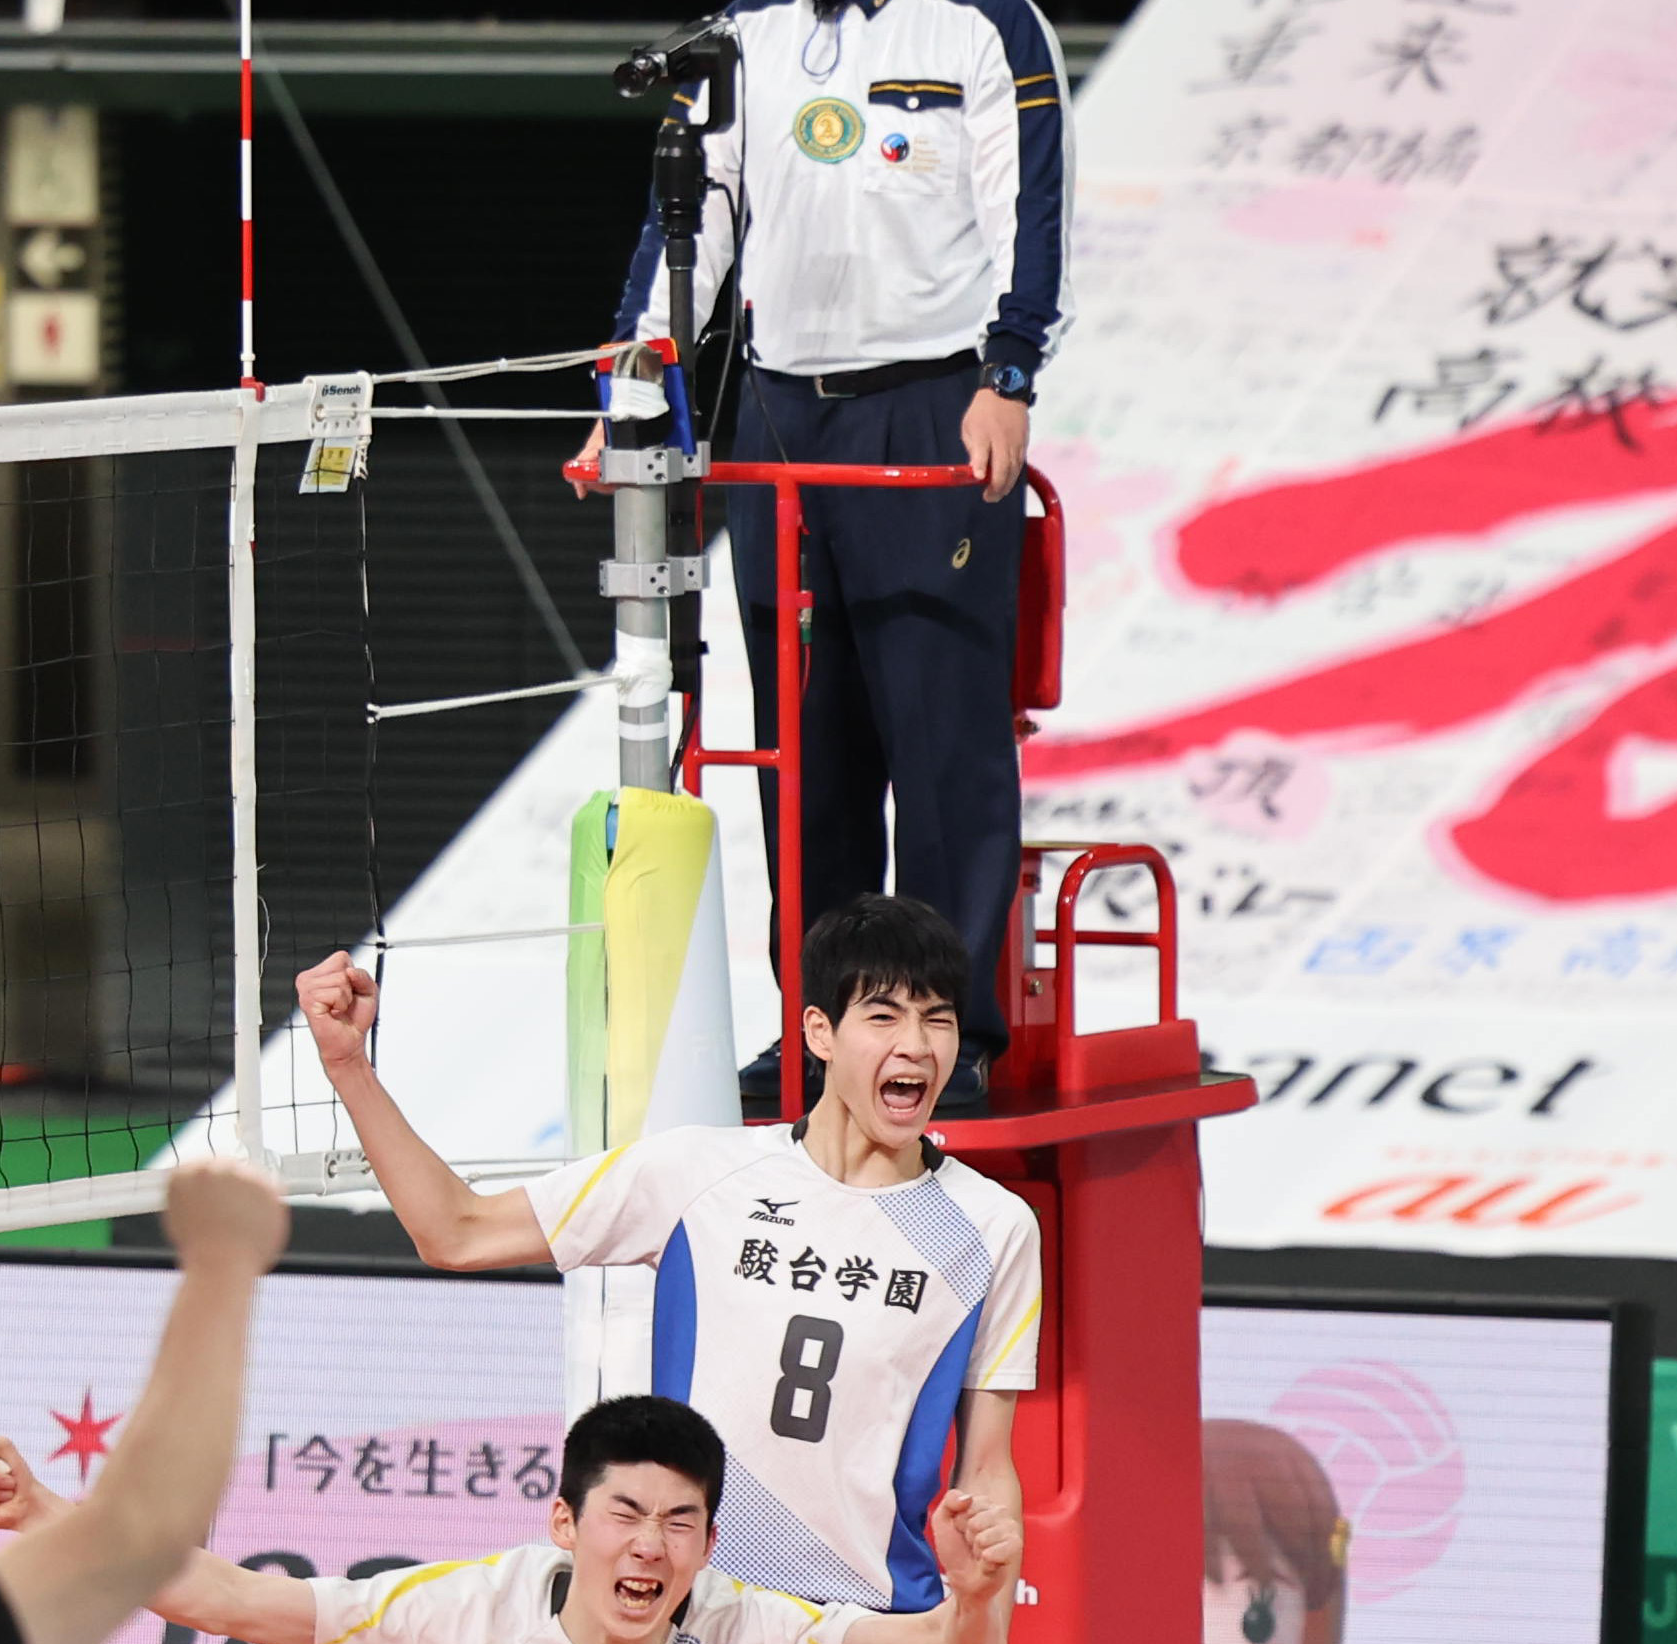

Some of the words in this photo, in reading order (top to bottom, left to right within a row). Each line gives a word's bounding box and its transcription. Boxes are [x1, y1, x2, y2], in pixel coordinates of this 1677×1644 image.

[734, 1238, 929, 1314] 駿台学園
[770, 1314, 844, 1444] 8
